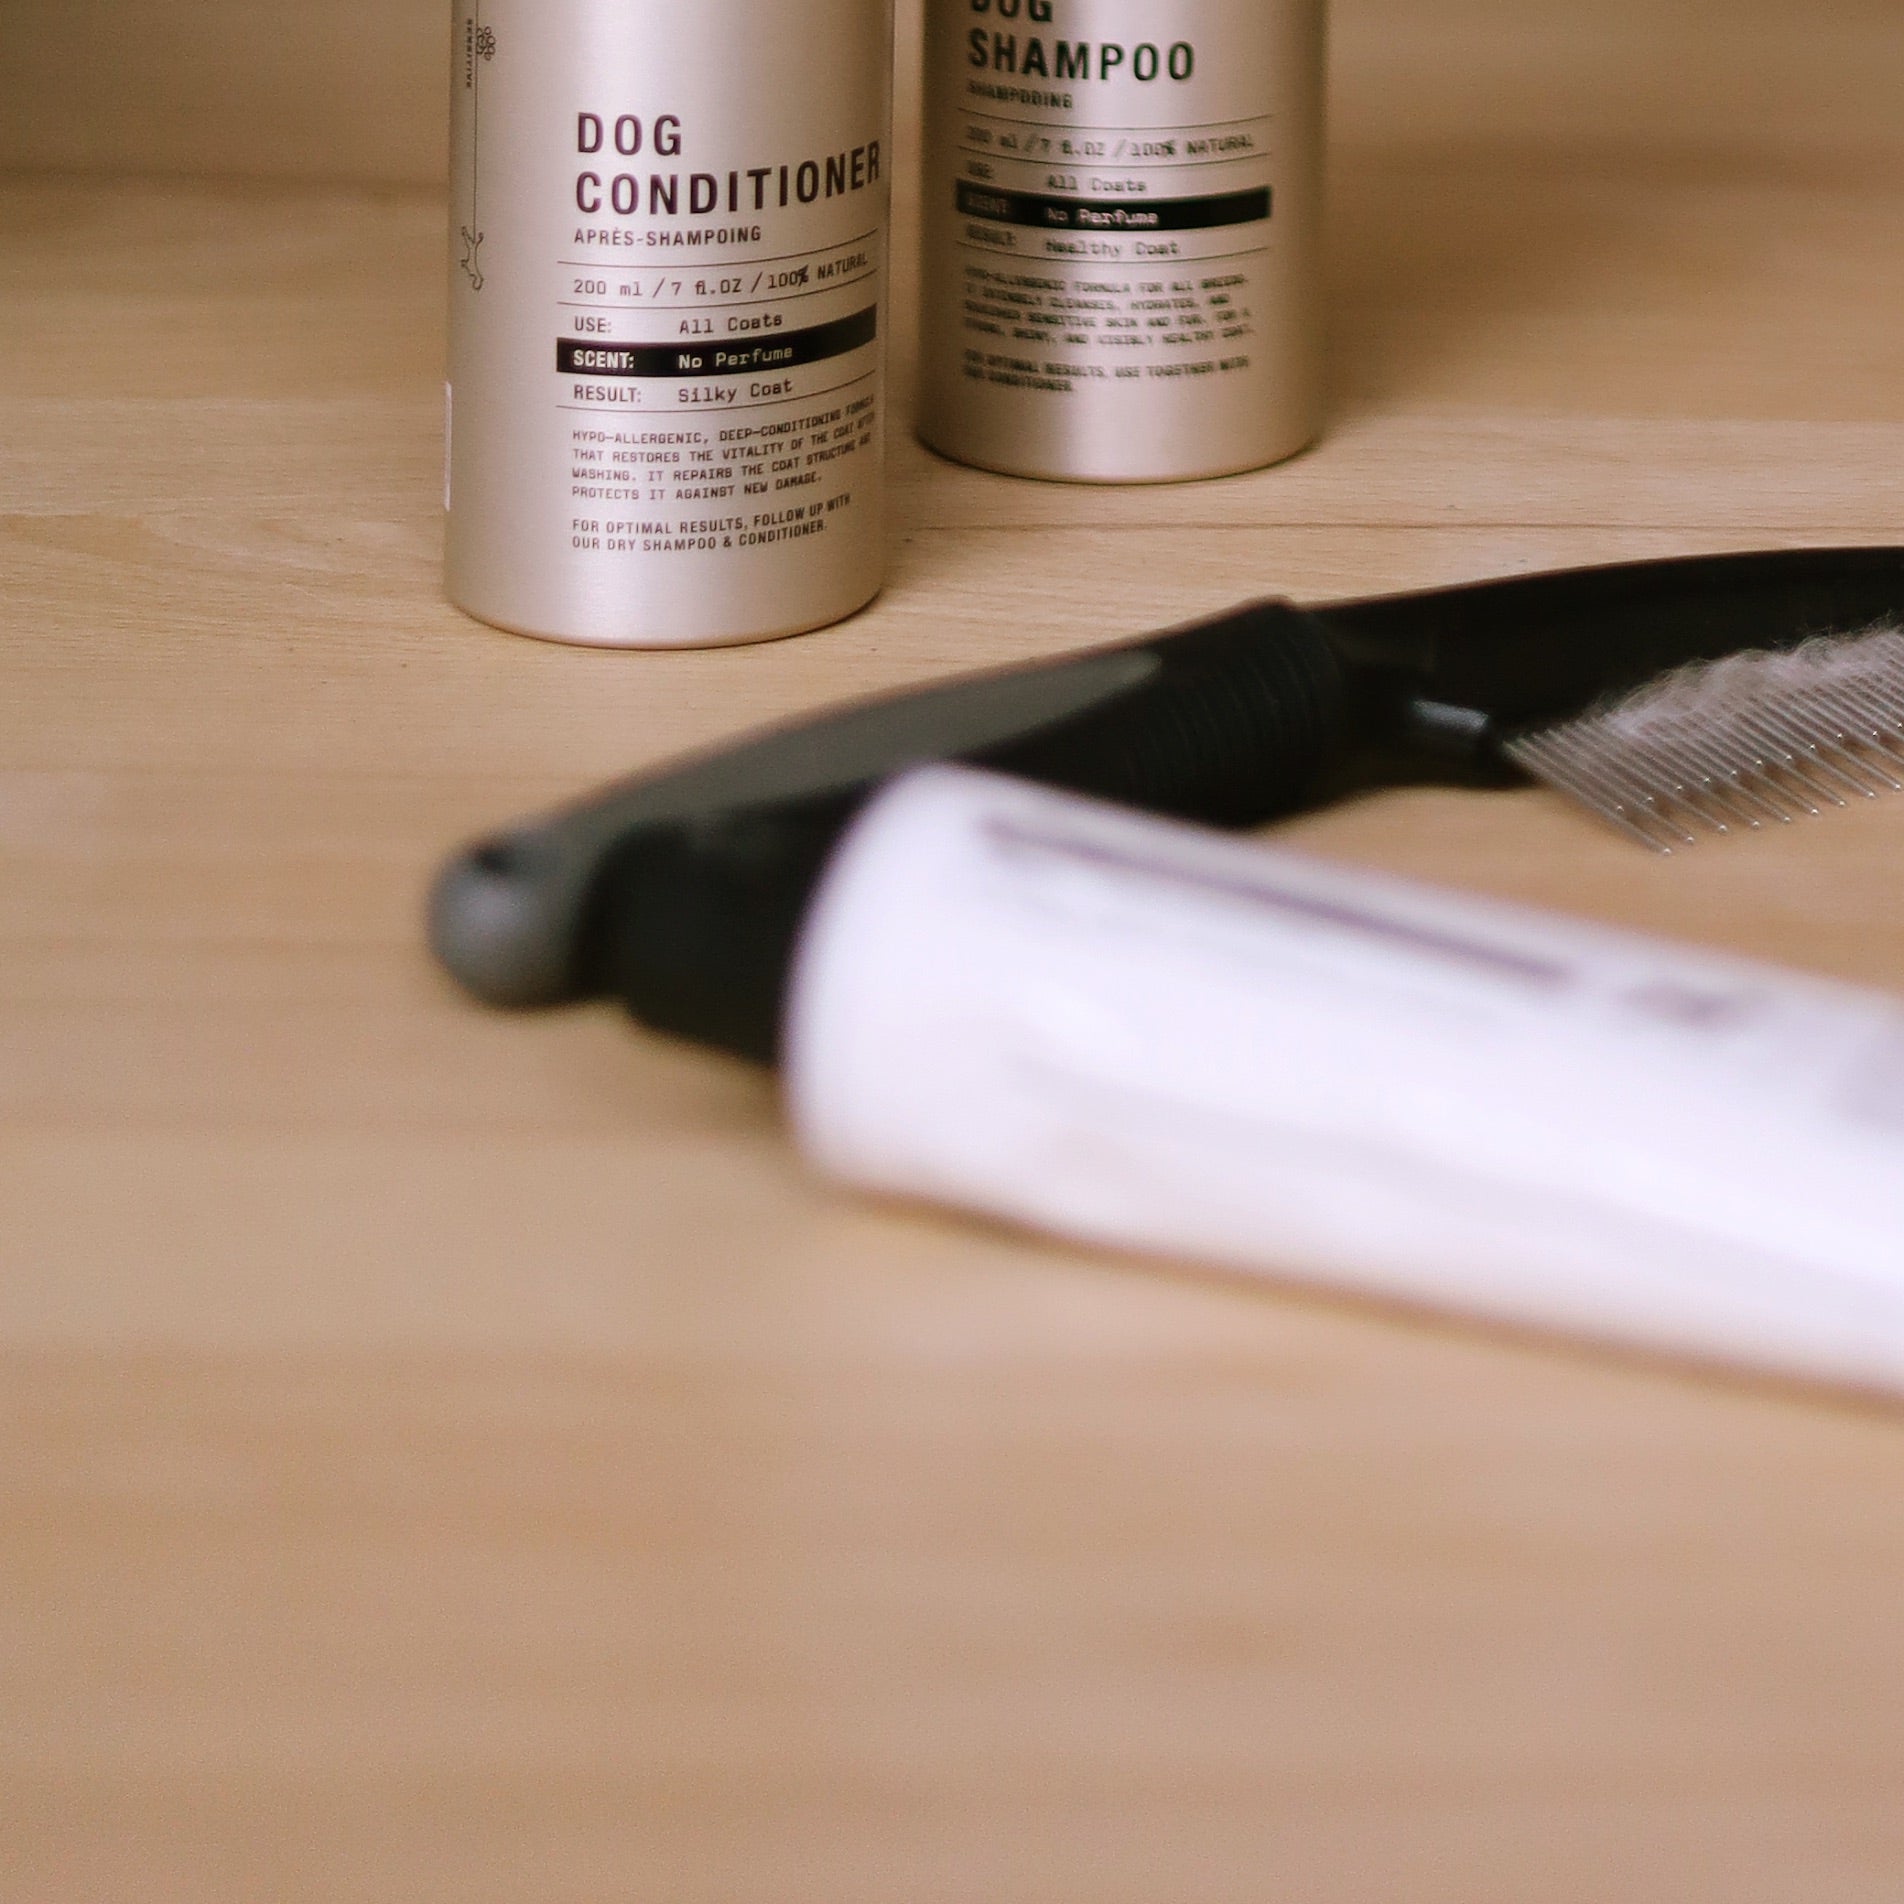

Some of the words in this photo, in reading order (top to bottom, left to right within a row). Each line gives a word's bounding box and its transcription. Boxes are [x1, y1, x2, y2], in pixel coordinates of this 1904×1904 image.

[968, 27, 1194, 82] SHAMPOO
[577, 111, 682, 156] DOG
[576, 140, 880, 216] CONDITIONER
[574, 226, 761, 246] APRÈS-SHAMPOING
[573, 279, 606, 295] 200
[620, 281, 643, 297] ml
[671, 281, 682, 296] 7
[818, 252, 868, 280] NATURAL
[574, 316, 612, 333] USE:
[680, 318, 713, 334] All
[728, 313, 784, 332] Coats
[573, 349, 635, 370] SCENT:
[678, 353, 703, 370] No
[715, 346, 793, 368] Perfume
[573, 384, 642, 403] RESULT:
[678, 384, 738, 404] Silky
[750, 378, 793, 398] Coat
[572, 429, 709, 445] HYPO-ALLERGENIC,
[719, 408, 842, 442] DEEP-CONDITIONING
[571, 467, 637, 481] WASHING.
[648, 469, 665, 482] IT
[673, 467, 733, 481] REPAIRS
[741, 463, 764, 477] THE
[771, 458, 801, 475] COAT
[806, 438, 856, 466] STRUCTURE
[572, 448, 605, 462] THAT
[612, 450, 680, 463] RESTORES
[689, 449, 713, 462] THE
[722, 442, 785, 460] VITALITY
[791, 436, 805, 451] OF
[810, 432, 828, 446] THE
[571, 485, 640, 500] PROTECTS
[649, 488, 666, 500] IT
[675, 485, 736, 500] AGAINST
[744, 481, 769, 495] NEW
[775, 471, 822, 491] DAMAGE.
[572, 518, 600, 533] FOR
[606, 521, 673, 534] OPTIMAL
[680, 516, 748, 533] RESULTS,
[754, 507, 805, 528] FOLLOW
[809, 502, 824, 518] UP
[826, 493, 851, 512] WITH
[572, 535, 600, 550] OUR
[607, 538, 637, 551] DRY
[642, 536, 717, 551] SHAMPOO
[723, 535, 732, 548] &
